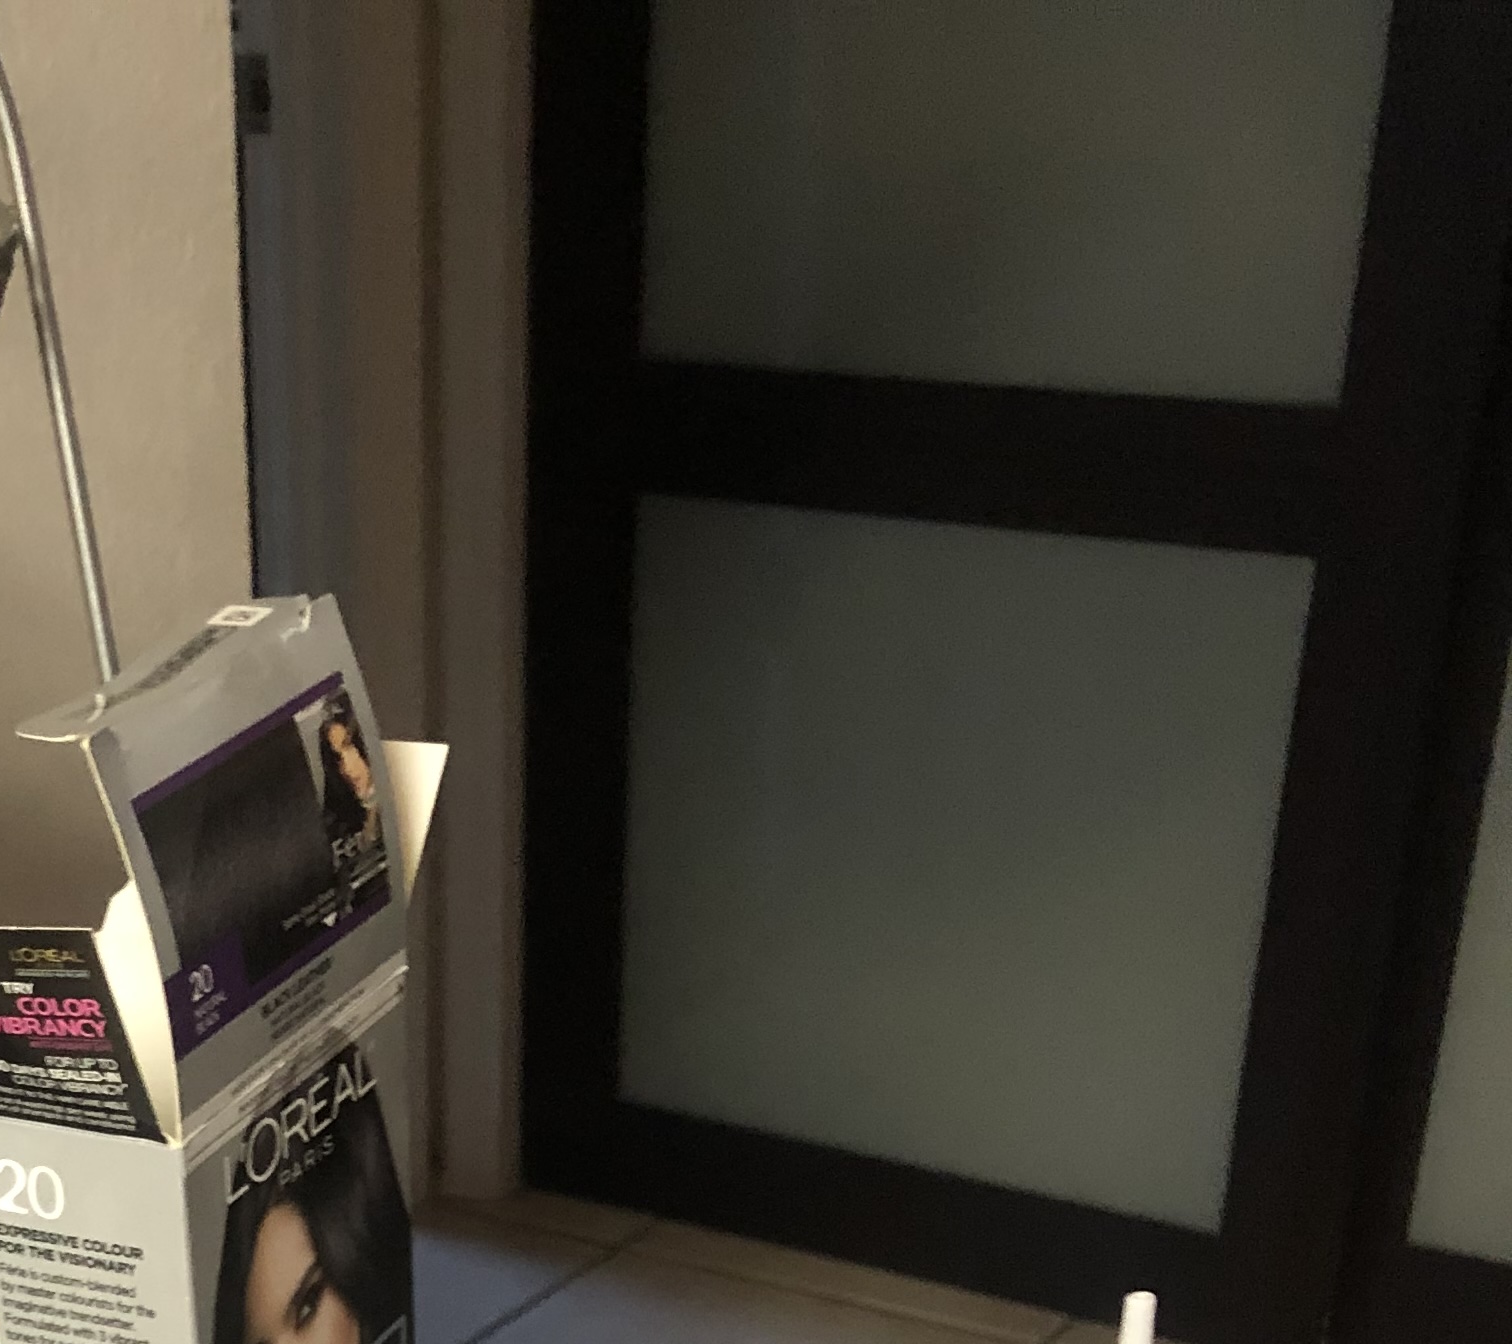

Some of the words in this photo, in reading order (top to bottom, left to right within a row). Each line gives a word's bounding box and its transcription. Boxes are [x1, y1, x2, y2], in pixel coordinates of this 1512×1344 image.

[15, 996, 104, 1018] COLOR
[224, 1045, 378, 1203] L'ORÉAL
[28, 1244, 56, 1262] THE
[58, 1250, 137, 1276] VISIONARY
[82, 1238, 145, 1261] COLOUR
